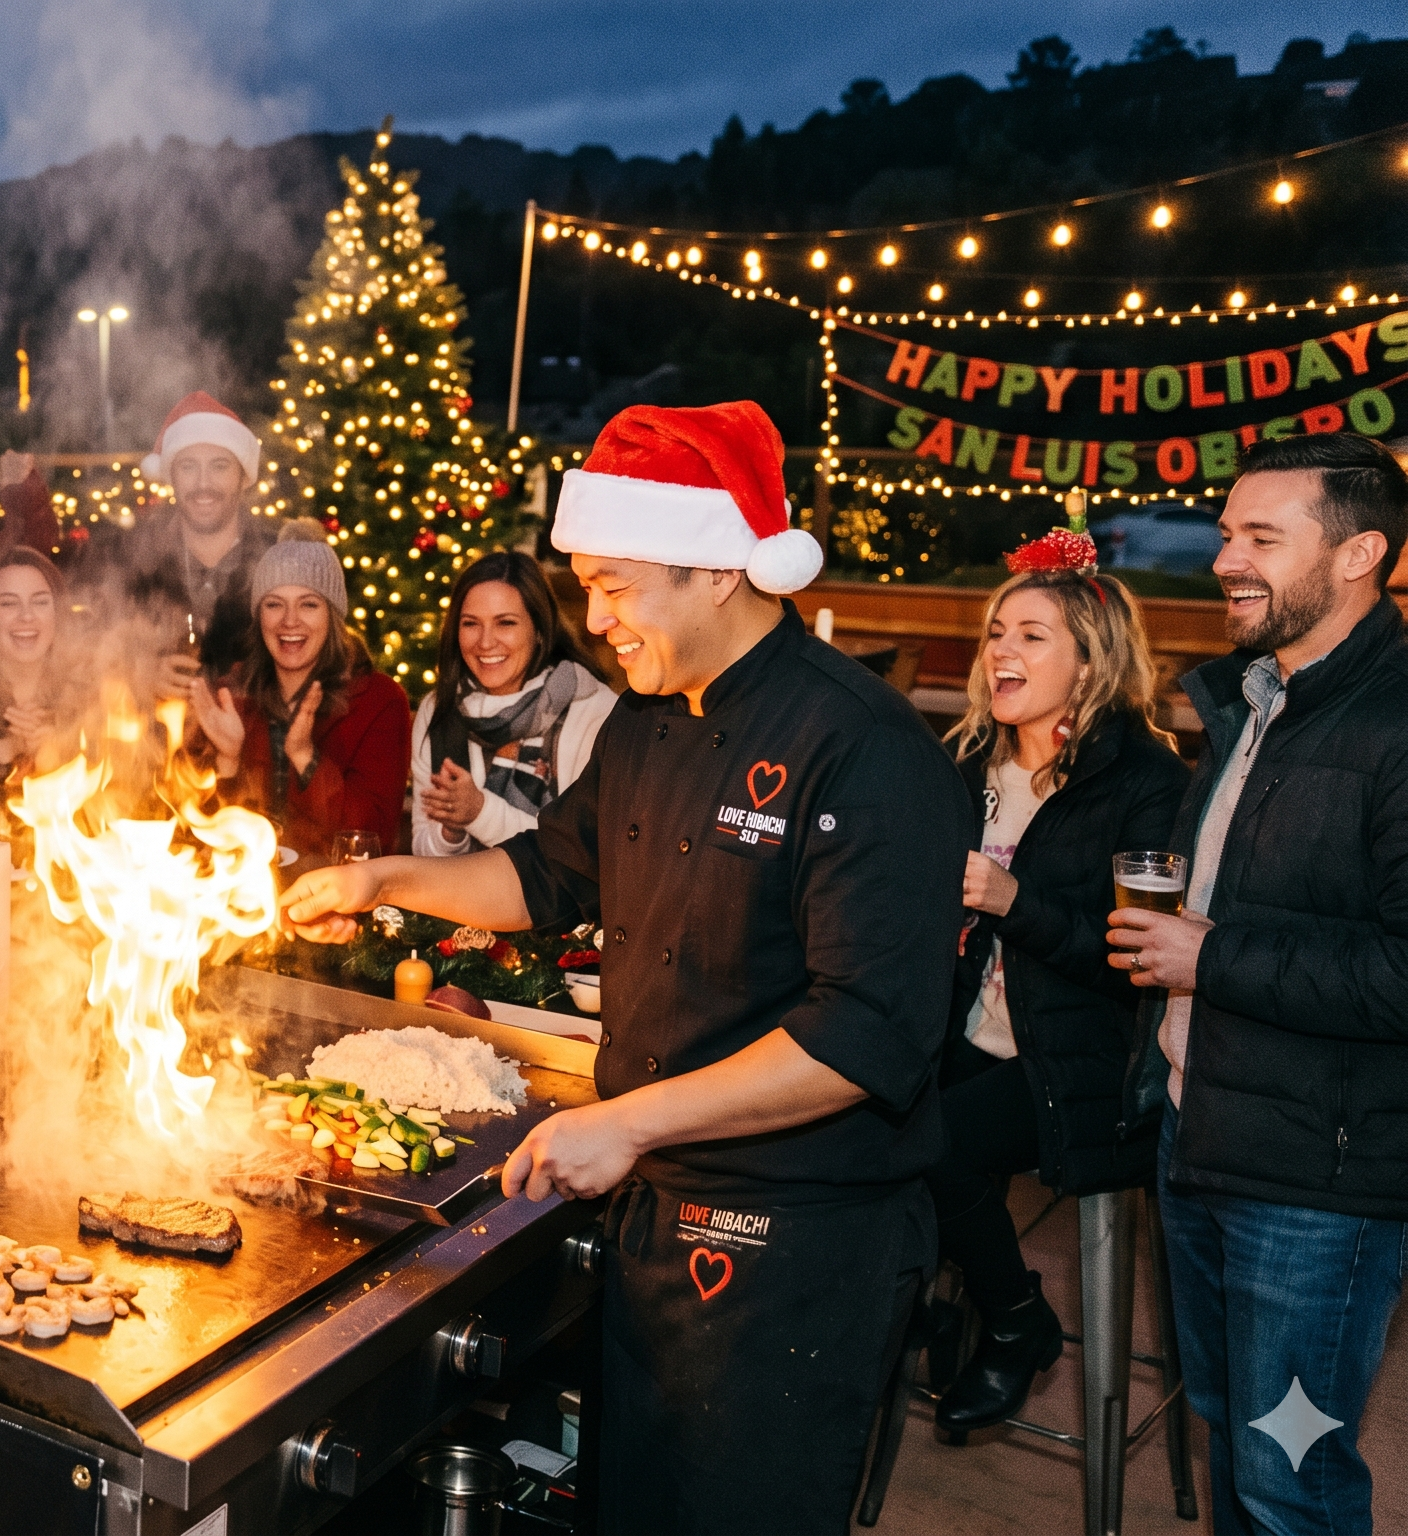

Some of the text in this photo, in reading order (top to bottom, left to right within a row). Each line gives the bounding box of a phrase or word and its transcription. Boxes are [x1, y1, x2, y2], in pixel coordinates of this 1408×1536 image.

[886, 310, 1408, 414] HAPPY HOLIDAYS
[887, 405, 1000, 474] SAN
[1009, 434, 1138, 486] LUIS
[717, 805, 786, 836] LOVE HIBACHI
[739, 829, 760, 845] SLO
[679, 1202, 711, 1226] LOVE
[710, 1209, 770, 1236] HIBACHI
